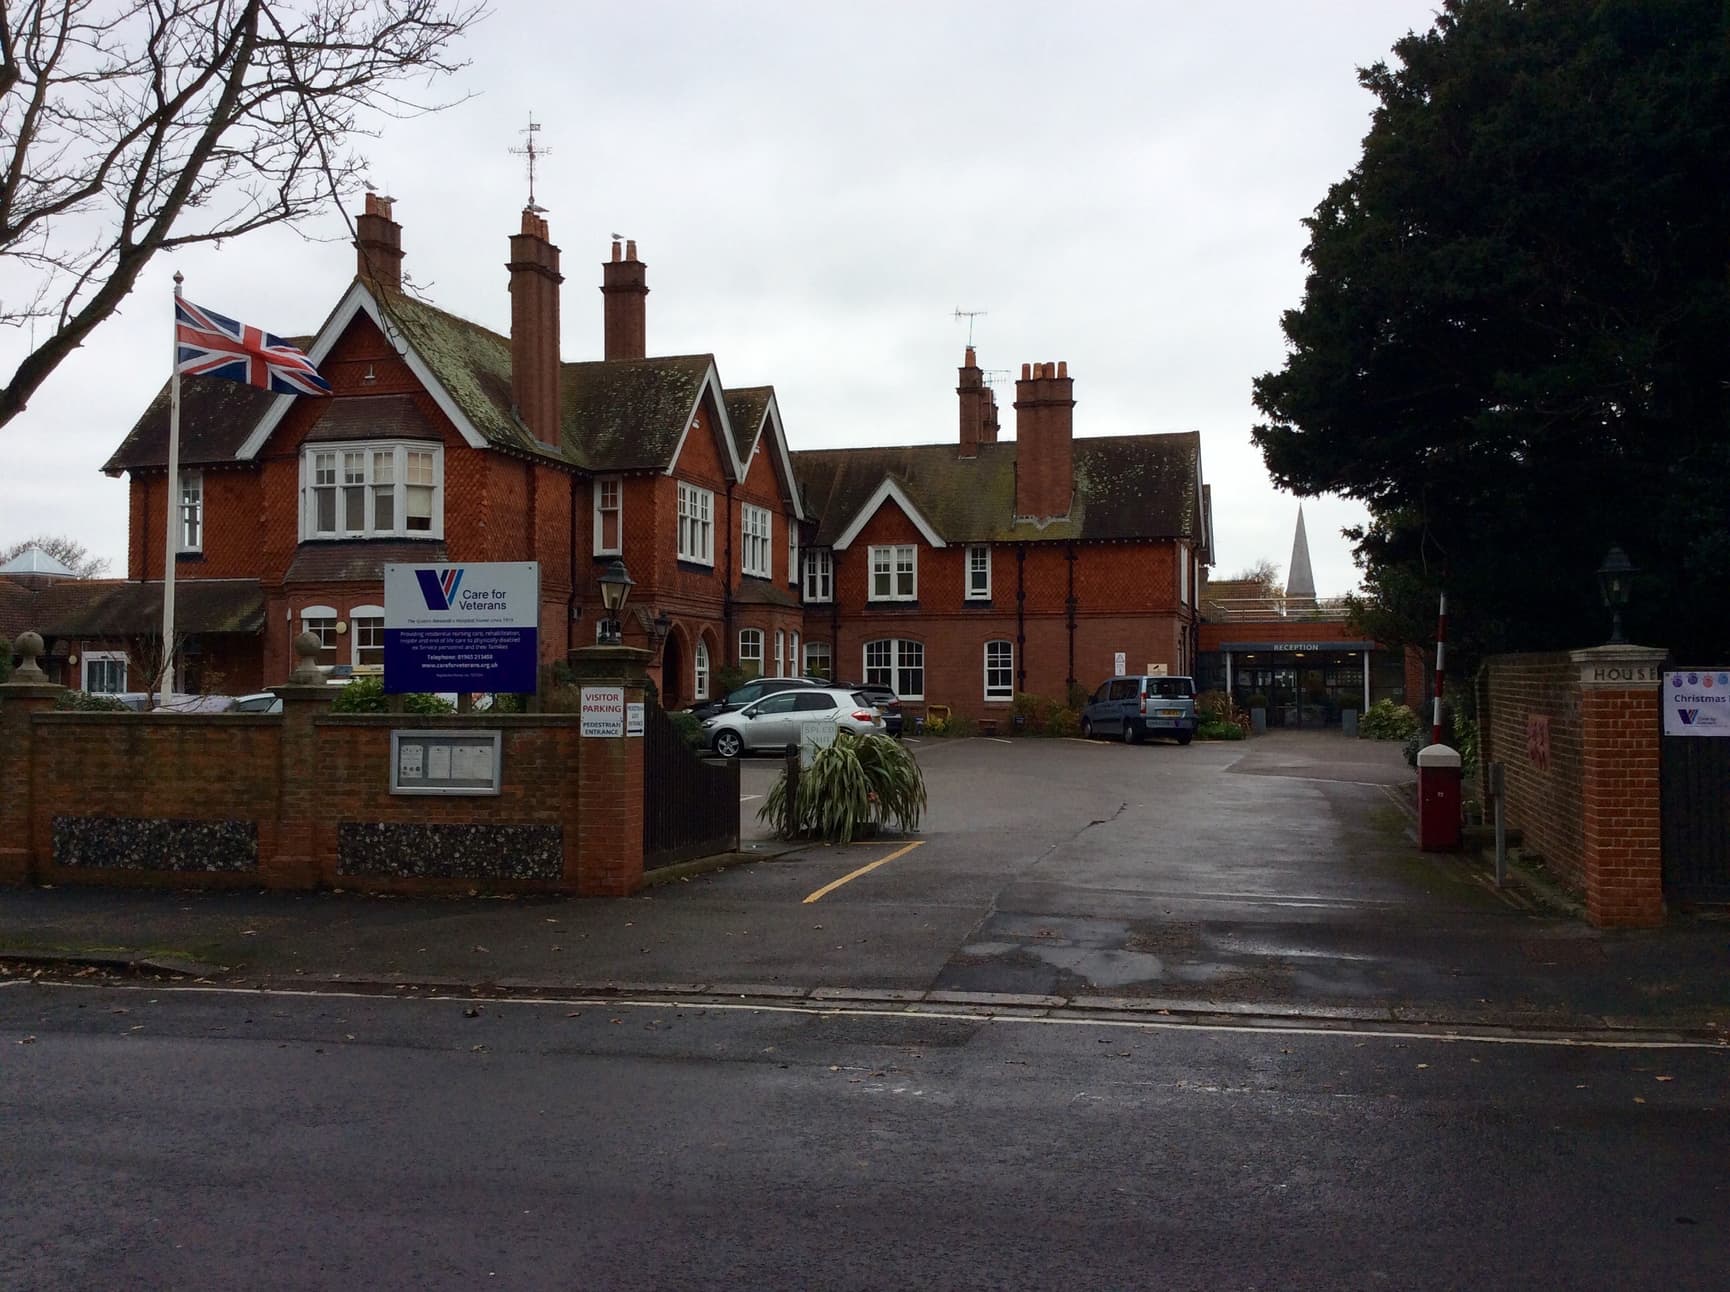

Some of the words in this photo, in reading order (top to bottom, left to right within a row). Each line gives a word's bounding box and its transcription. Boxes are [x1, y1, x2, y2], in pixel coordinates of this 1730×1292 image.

[462, 589, 489, 600] Care
[491, 588, 507, 599] for
[458, 600, 508, 611] Veterans
[1273, 643, 1319, 651] RECEPTION
[1594, 668, 1657, 681] HOUSE
[585, 693, 620, 702] VISITOR
[1674, 693, 1727, 703] Christmas
[582, 704, 622, 713] PARKING
[585, 728, 619, 736] ENTRANCE
[804, 726, 834, 734] SPEED
